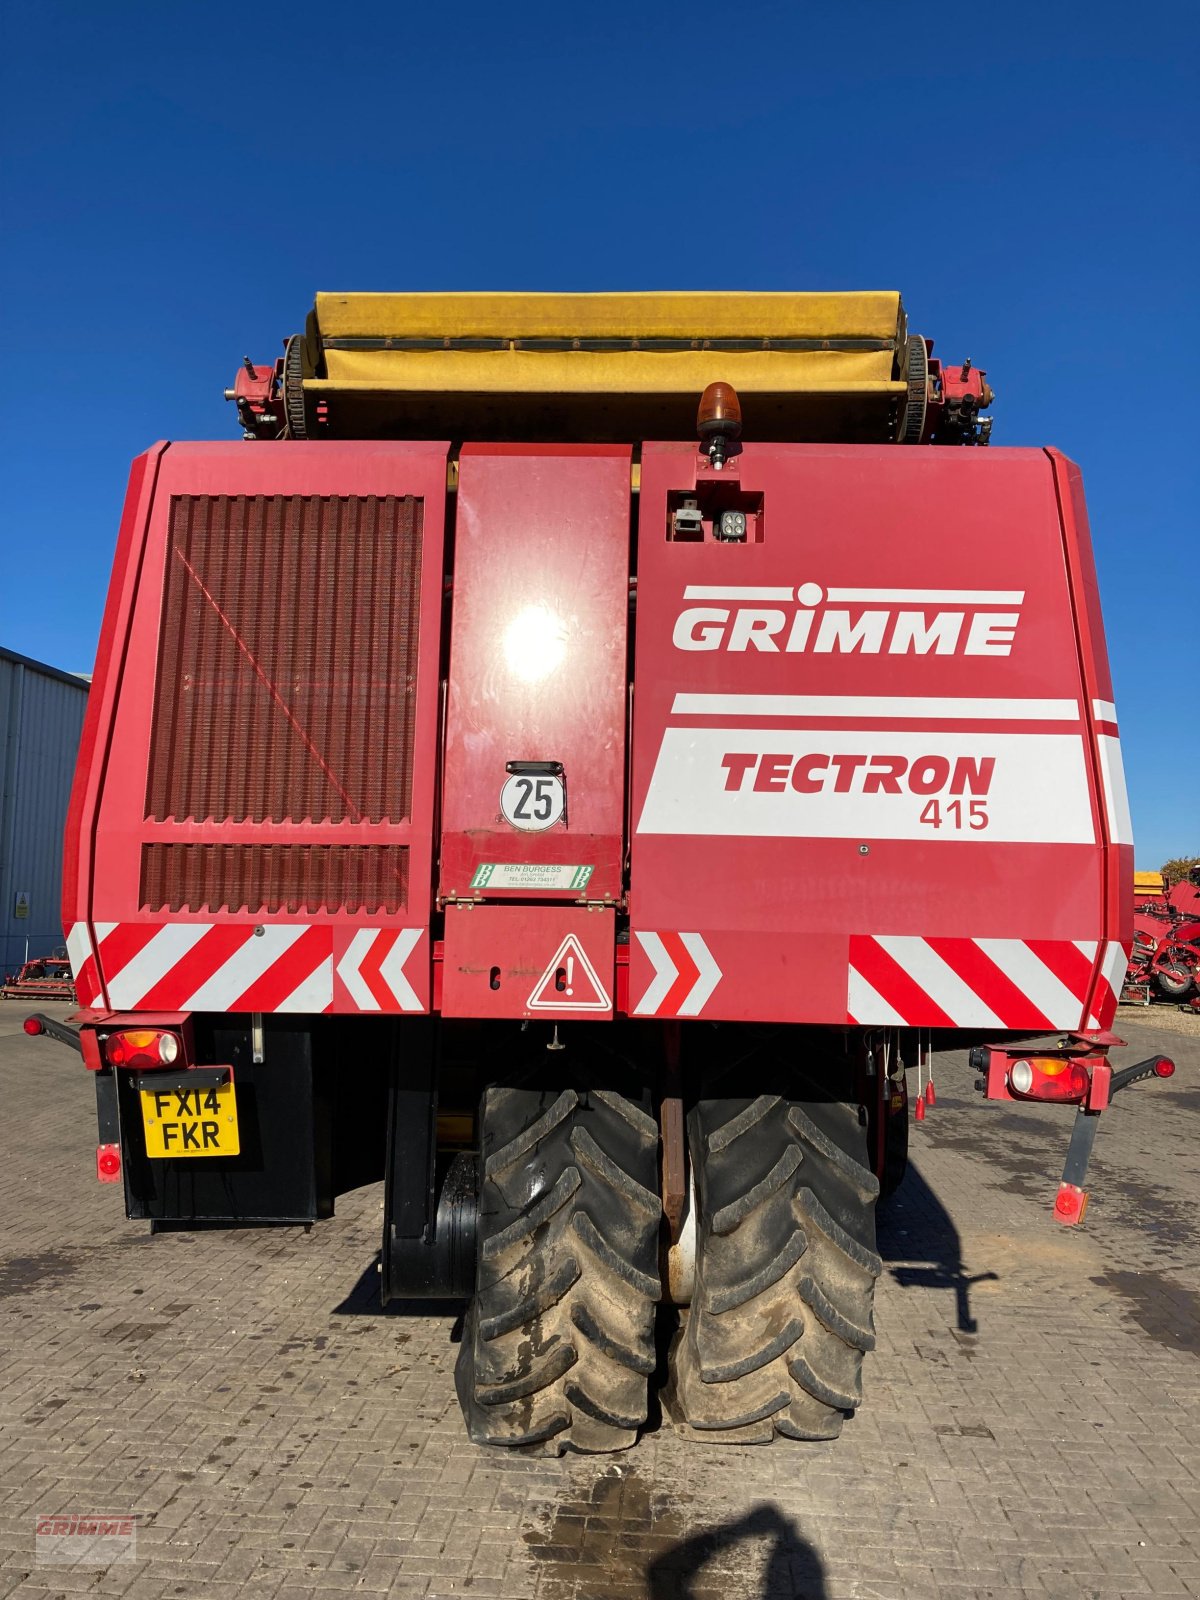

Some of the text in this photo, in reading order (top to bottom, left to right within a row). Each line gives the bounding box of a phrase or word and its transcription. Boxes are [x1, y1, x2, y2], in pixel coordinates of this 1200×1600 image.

[672, 582, 1020, 656] GRIMME
[721, 753, 996, 795] TECTRON
[513, 778, 553, 820] 25
[919, 799, 989, 830] 415
[522, 865, 562, 873] BURGESS
[155, 1088, 221, 1118] FX14
[162, 1121, 220, 1150] FKR
